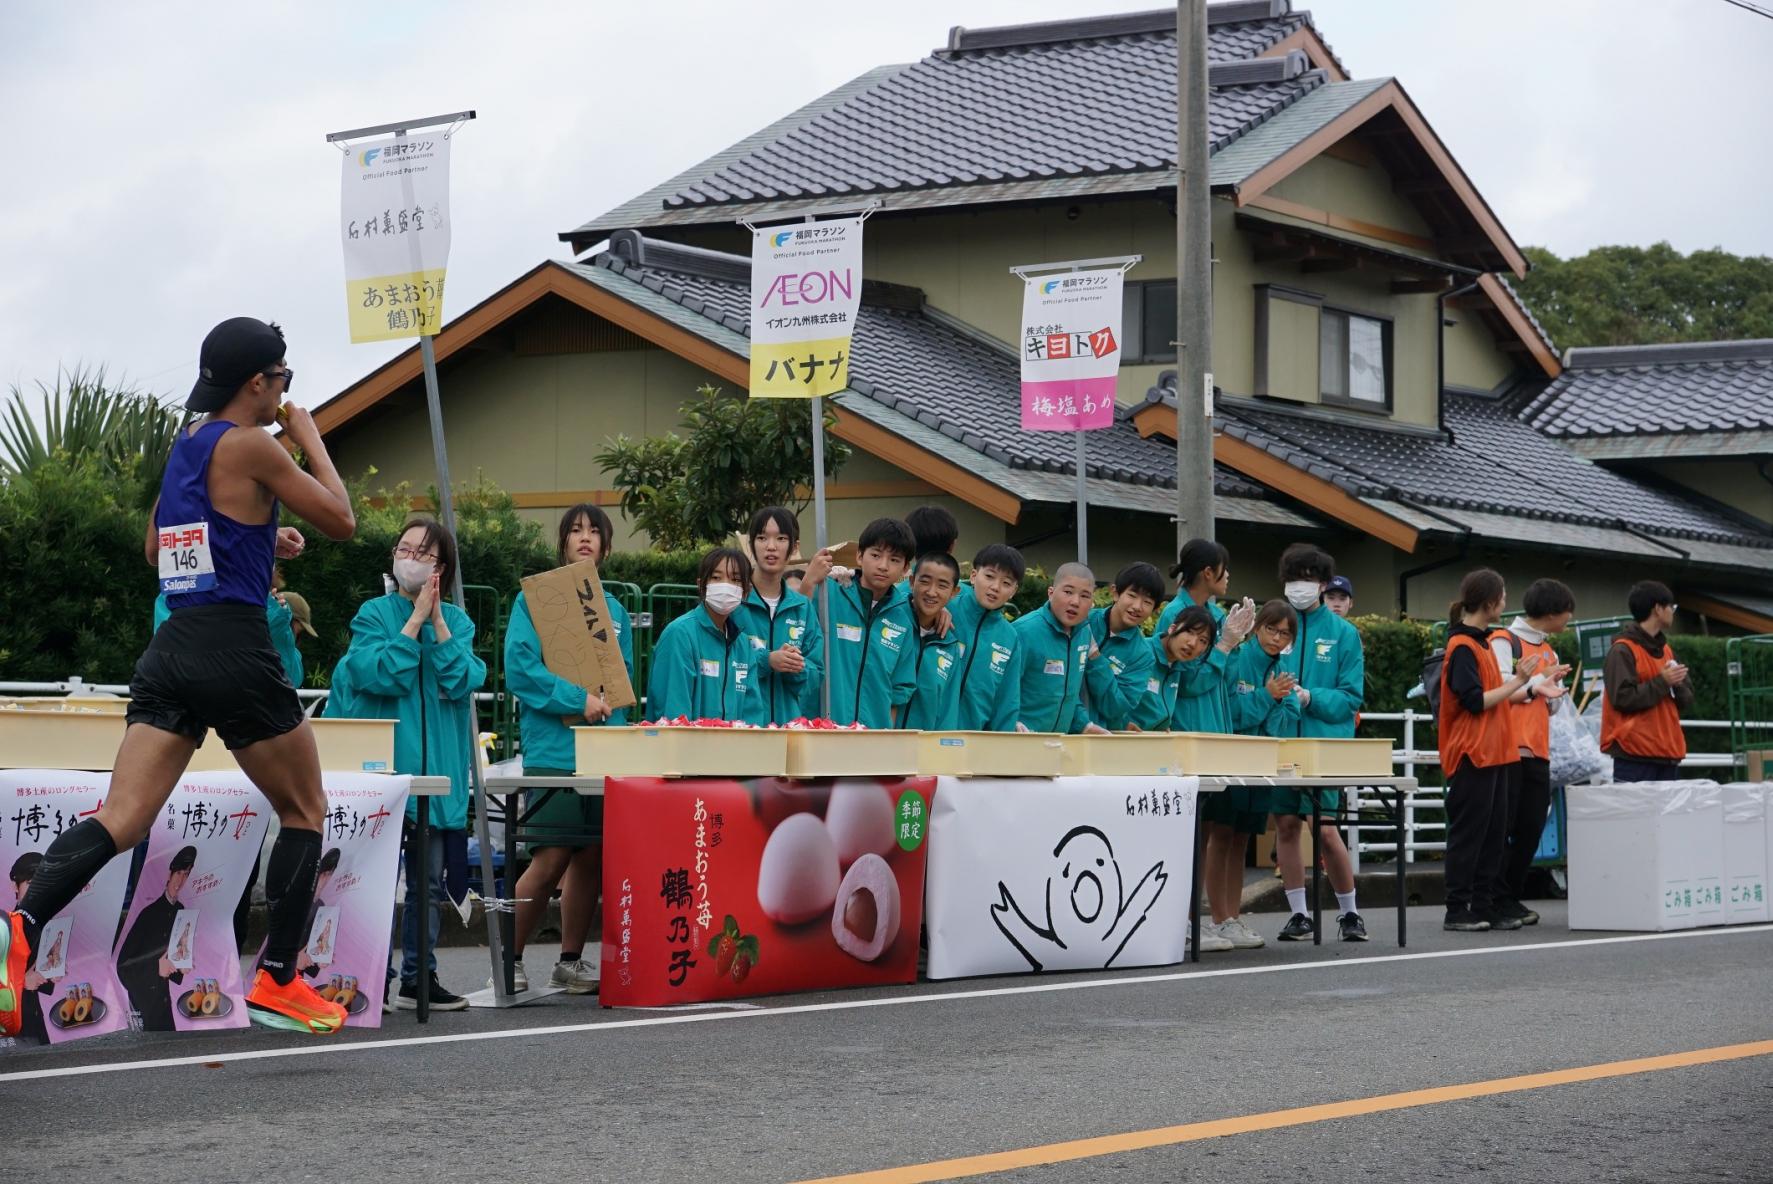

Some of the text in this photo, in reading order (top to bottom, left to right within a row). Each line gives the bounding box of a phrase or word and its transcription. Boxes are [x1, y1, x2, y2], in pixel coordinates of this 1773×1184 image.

[795, 226, 846, 240] 福岡マラソン
[773, 251, 797, 260] Official
[816, 247, 840, 255] Partner
[1062, 276, 1108, 288] 福岡マラソン
[766, 312, 847, 329] イオン九州株式会社
[1026, 324, 1063, 336] 株式会社
[1027, 330, 1111, 359] キヨトク
[765, 351, 844, 384] バナナ
[1031, 394, 1111, 416] 梅塩あめ
[171, 549, 198, 571] 146
[901, 801, 922, 820] 季節
[709, 813, 724, 848] 博多
[900, 822, 922, 840] 限定
[1665, 888, 1692, 908] ごみ箱
[1731, 884, 1763, 902] ごみ箱
[660, 867, 698, 987] 鶴乃子
